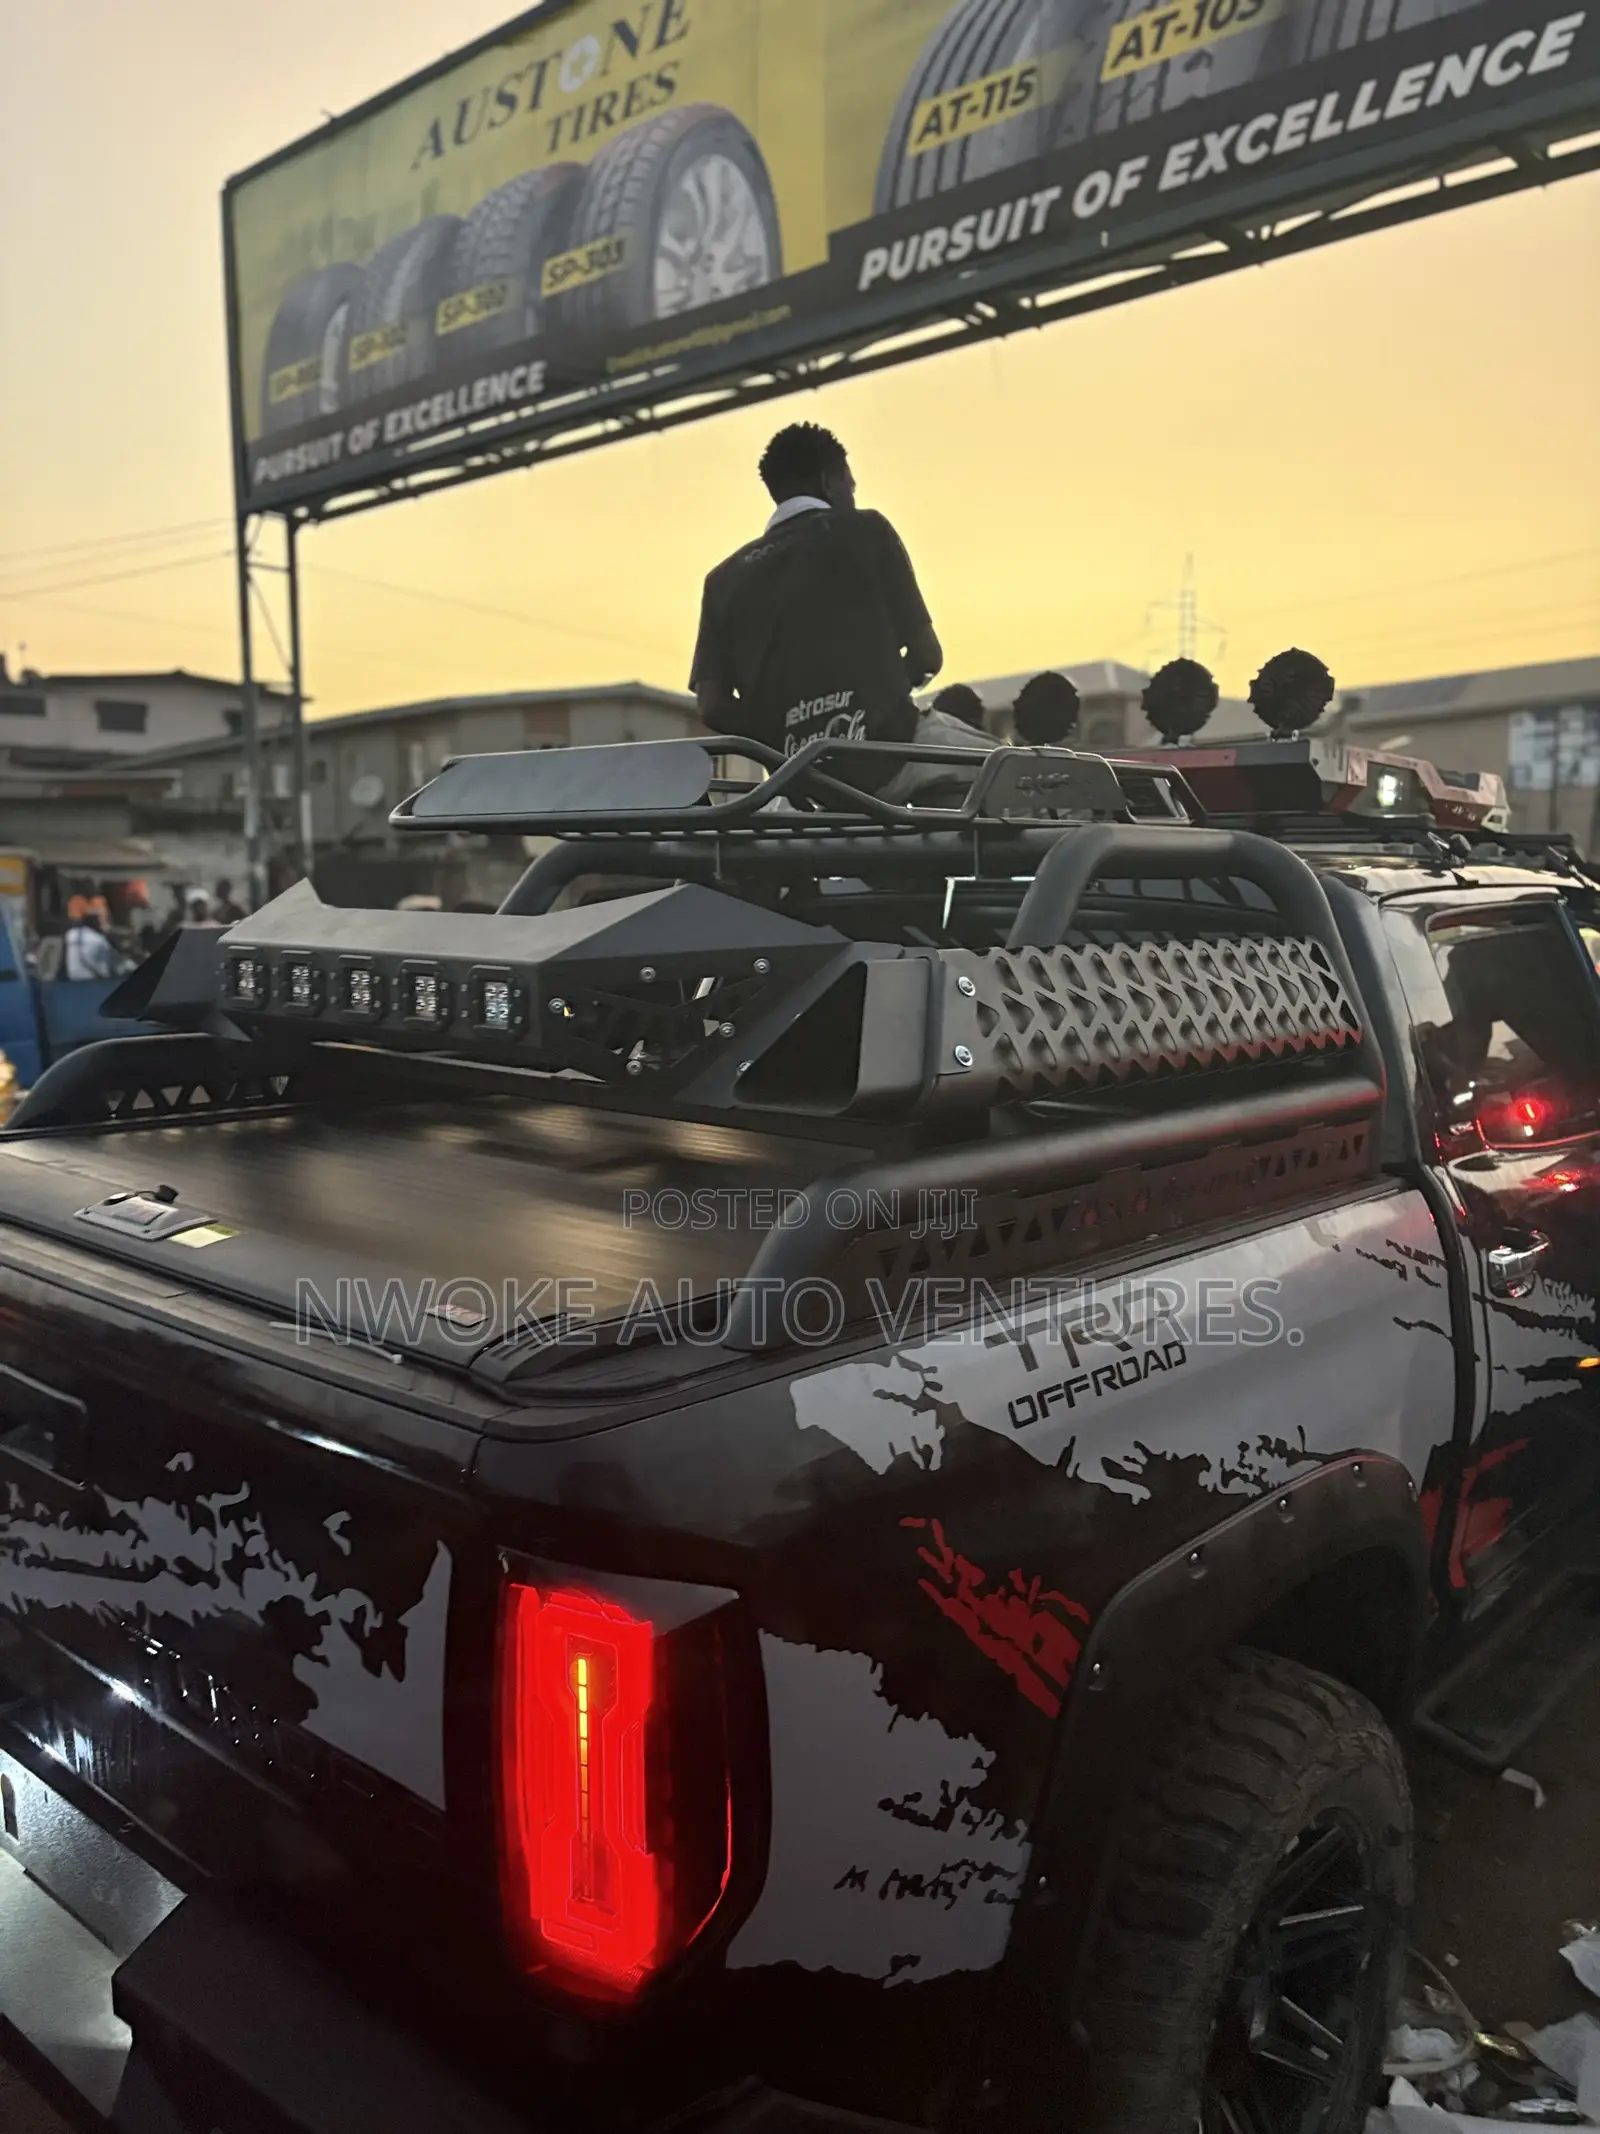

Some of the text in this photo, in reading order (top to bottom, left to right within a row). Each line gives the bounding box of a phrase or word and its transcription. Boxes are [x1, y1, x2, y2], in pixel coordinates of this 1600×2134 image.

[410, 0, 691, 170] AUSTONE
[545, 60, 680, 155] TIRES
[914, 66, 1038, 145] AT-115
[858, 11, 1585, 291] PURSUIT OF EXCELLENCE
[253, 431, 345, 485] PURSUIT
[348, 417, 380, 455] OF
[384, 360, 547, 442] EXCELLENCE
[1007, 1340, 1187, 1430] OFFROAD
